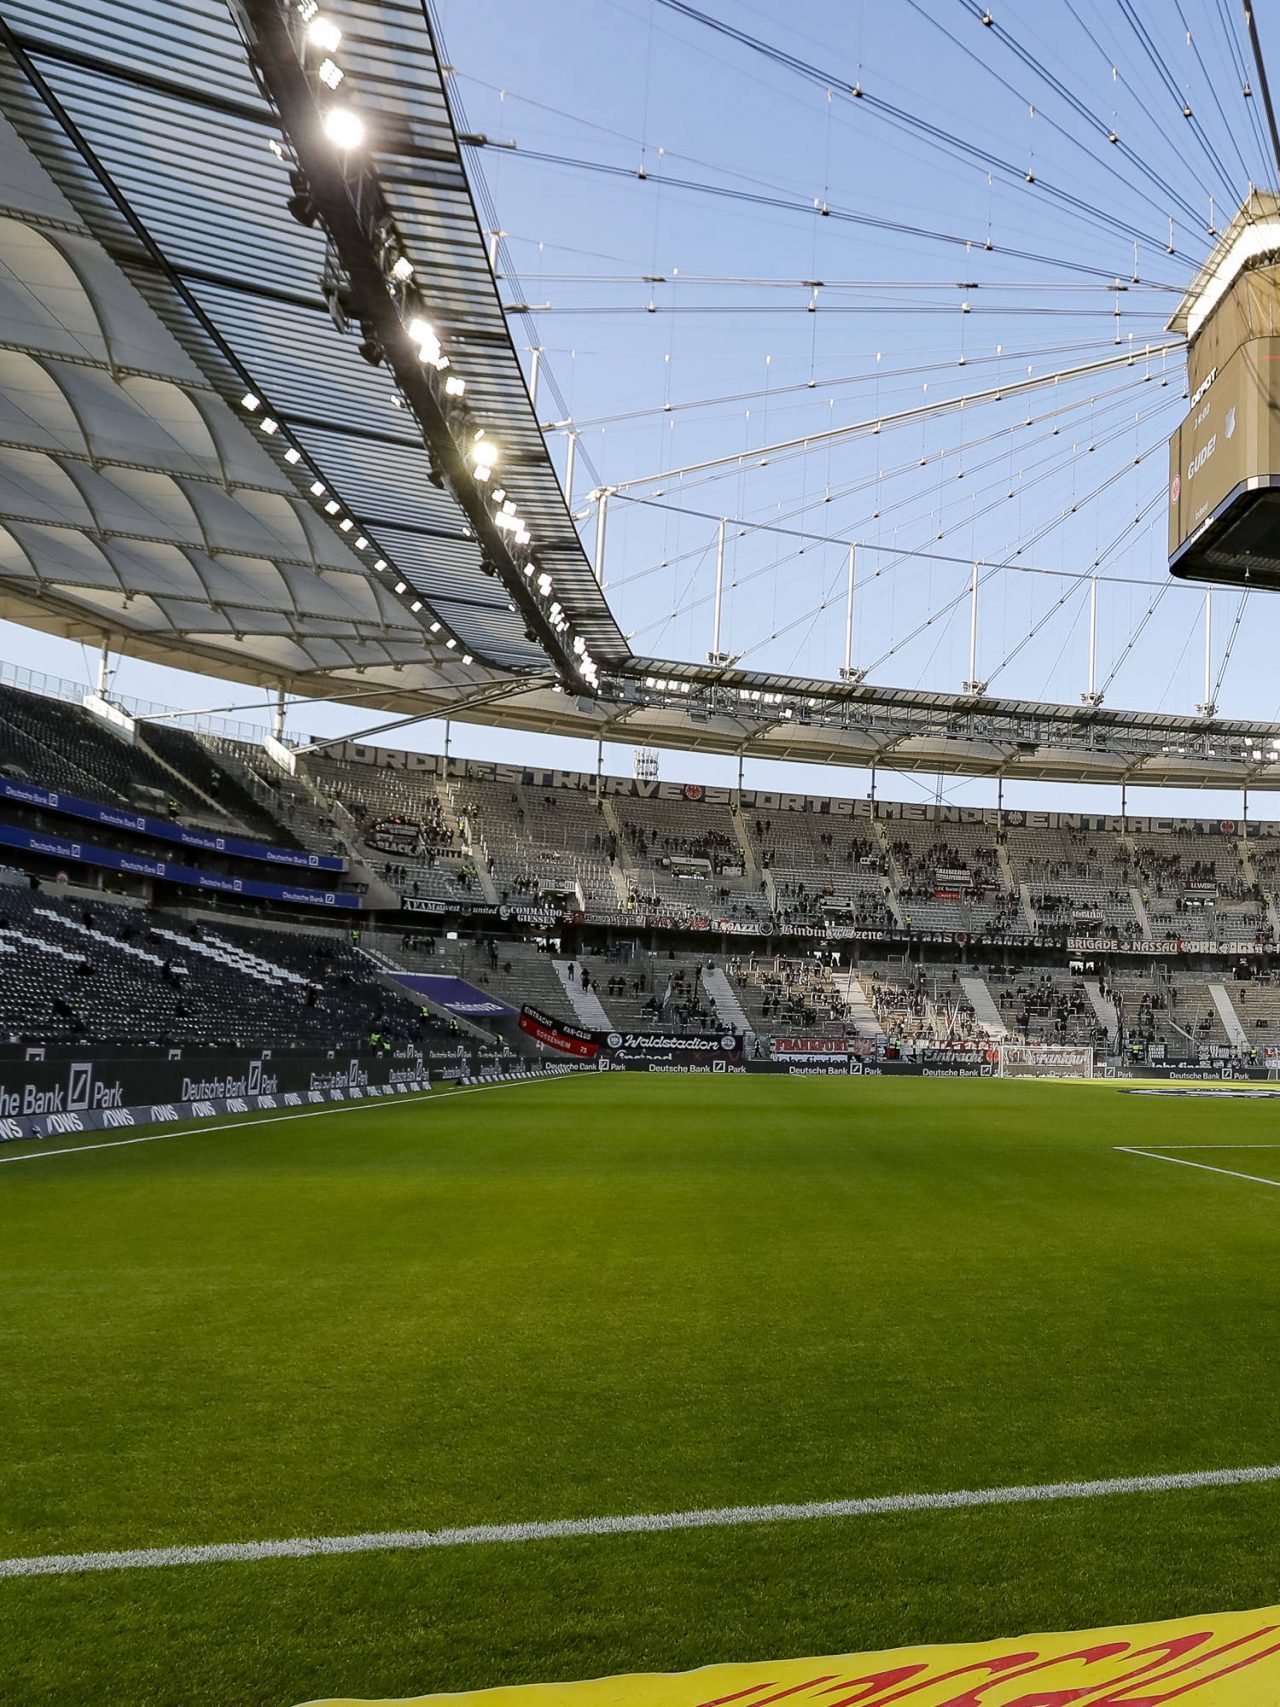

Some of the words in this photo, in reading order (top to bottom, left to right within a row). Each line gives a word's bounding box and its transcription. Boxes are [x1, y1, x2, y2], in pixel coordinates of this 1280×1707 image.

[1191, 367, 1217, 409] DEPOT
[1187, 433, 1217, 480] GUDE!
[704, 786, 1004, 827] SPORTGEMEINDE
[1026, 811, 1217, 835] EINTRACHT
[510, 906, 562, 917] COMMANDO
[517, 915, 556, 924] GIESSEN
[970, 933, 1062, 947] FRANKFURT
[1067, 938, 1118, 950] BRIGADE
[1133, 940, 1177, 952] NASSAU
[524, 1007, 553, 1027] EINTRACHT
[563, 1026, 592, 1040] FAN-CLUB
[624, 1034, 719, 1050] Waldstadion
[774, 1039, 849, 1051] FRANKFURT
[924, 1050, 984, 1063] Eintracht
[579, 1063, 597, 1071] Bank
[610, 1063, 626, 1071] Park
[649, 1064, 688, 1073] Deutsche
[690, 1064, 710, 1073] Bank
[728, 1065, 746, 1073] Park
[789, 1066, 827, 1075] Deutsche
[828, 1067, 848, 1075] Bank
[864, 1067, 882, 1075] Park
[922, 1068, 958, 1077] Deutsche
[959, 1069, 978, 1077] Bank
[1117, 1071, 1134, 1079] Park
[182, 1077, 224, 1101] Deutsche
[225, 1076, 247, 1097] Bank
[261, 1074, 278, 1094] Park
[23, 1083, 64, 1114] Bank
[93, 1081, 123, 1108] Park
[0, 1118, 23, 1139] WS
